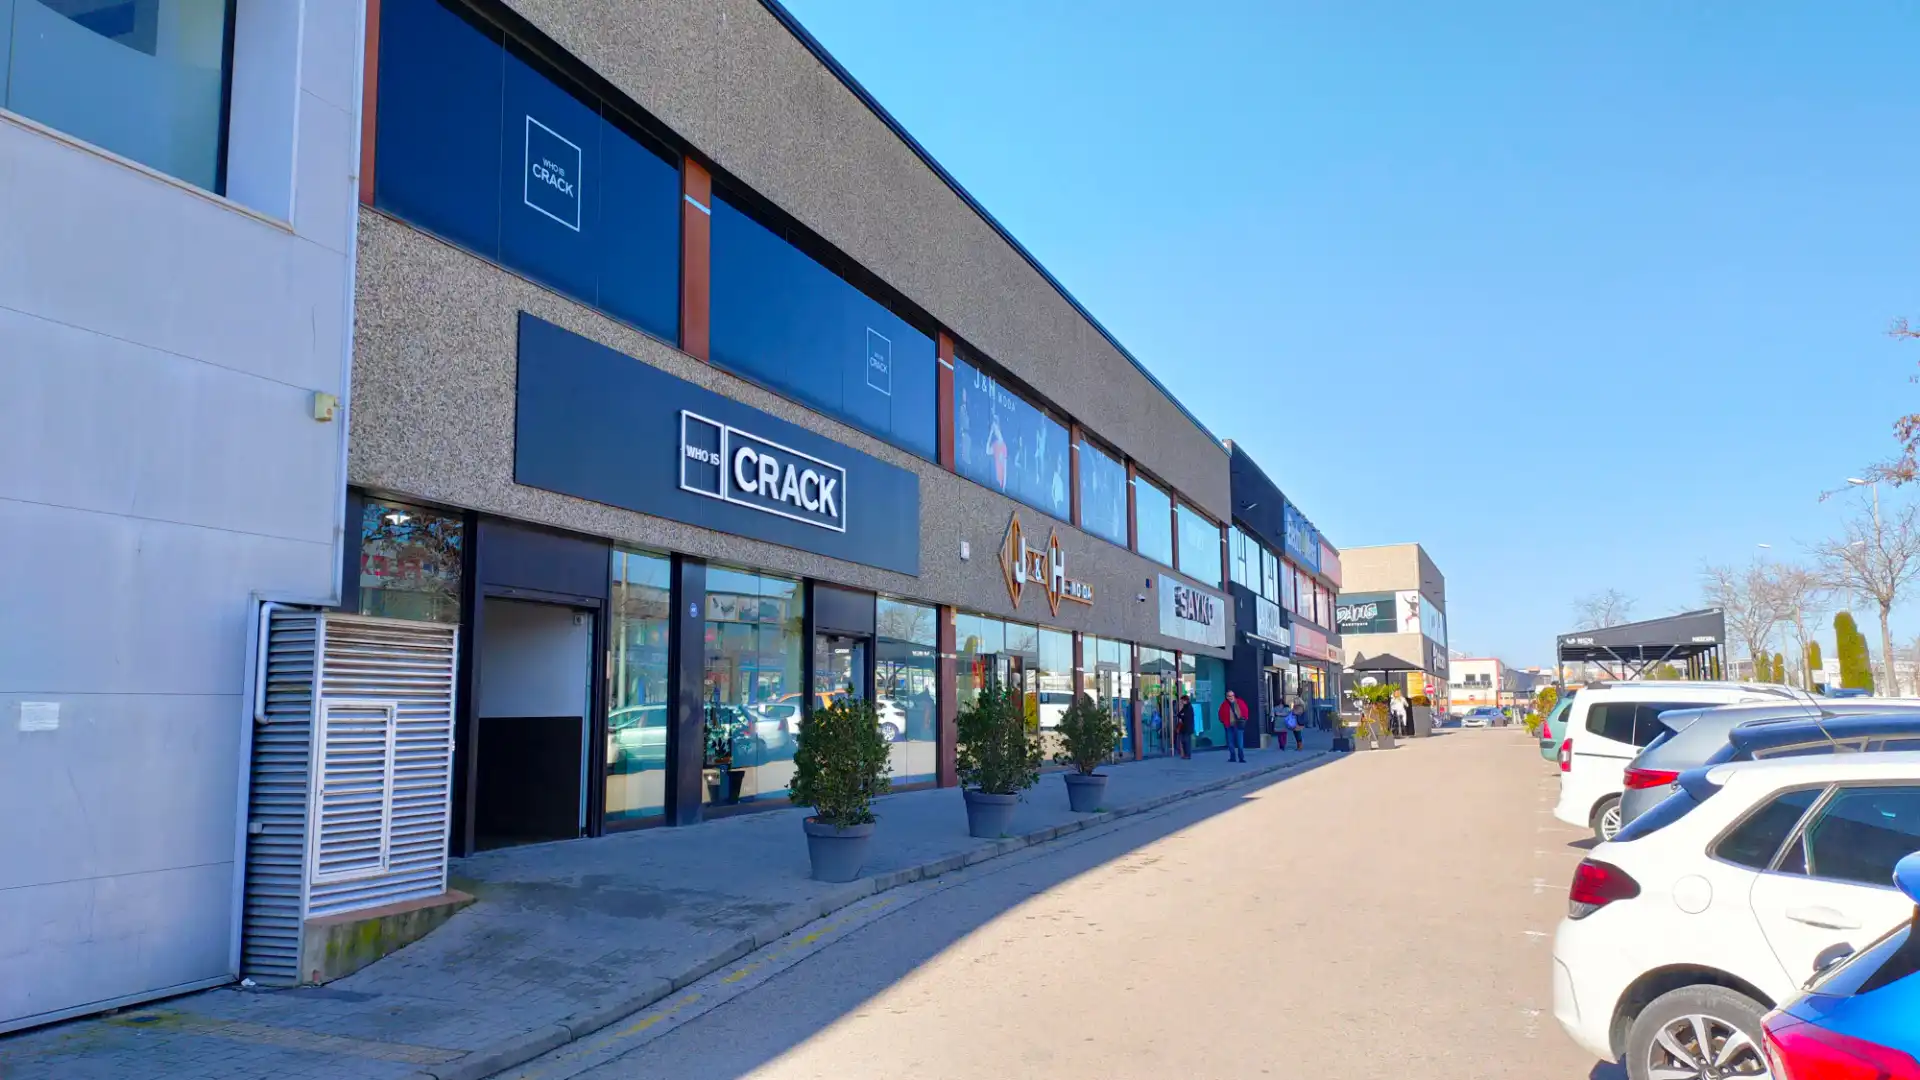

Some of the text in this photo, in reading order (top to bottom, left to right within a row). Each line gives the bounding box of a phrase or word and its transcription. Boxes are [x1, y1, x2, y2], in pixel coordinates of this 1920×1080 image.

[542, 157, 565, 177] WHO IS
[532, 163, 574, 198] CRACK
[998, 391, 1016, 411] MODA
[686, 445, 720, 466] WHO IS
[734, 446, 838, 518] CRACK
